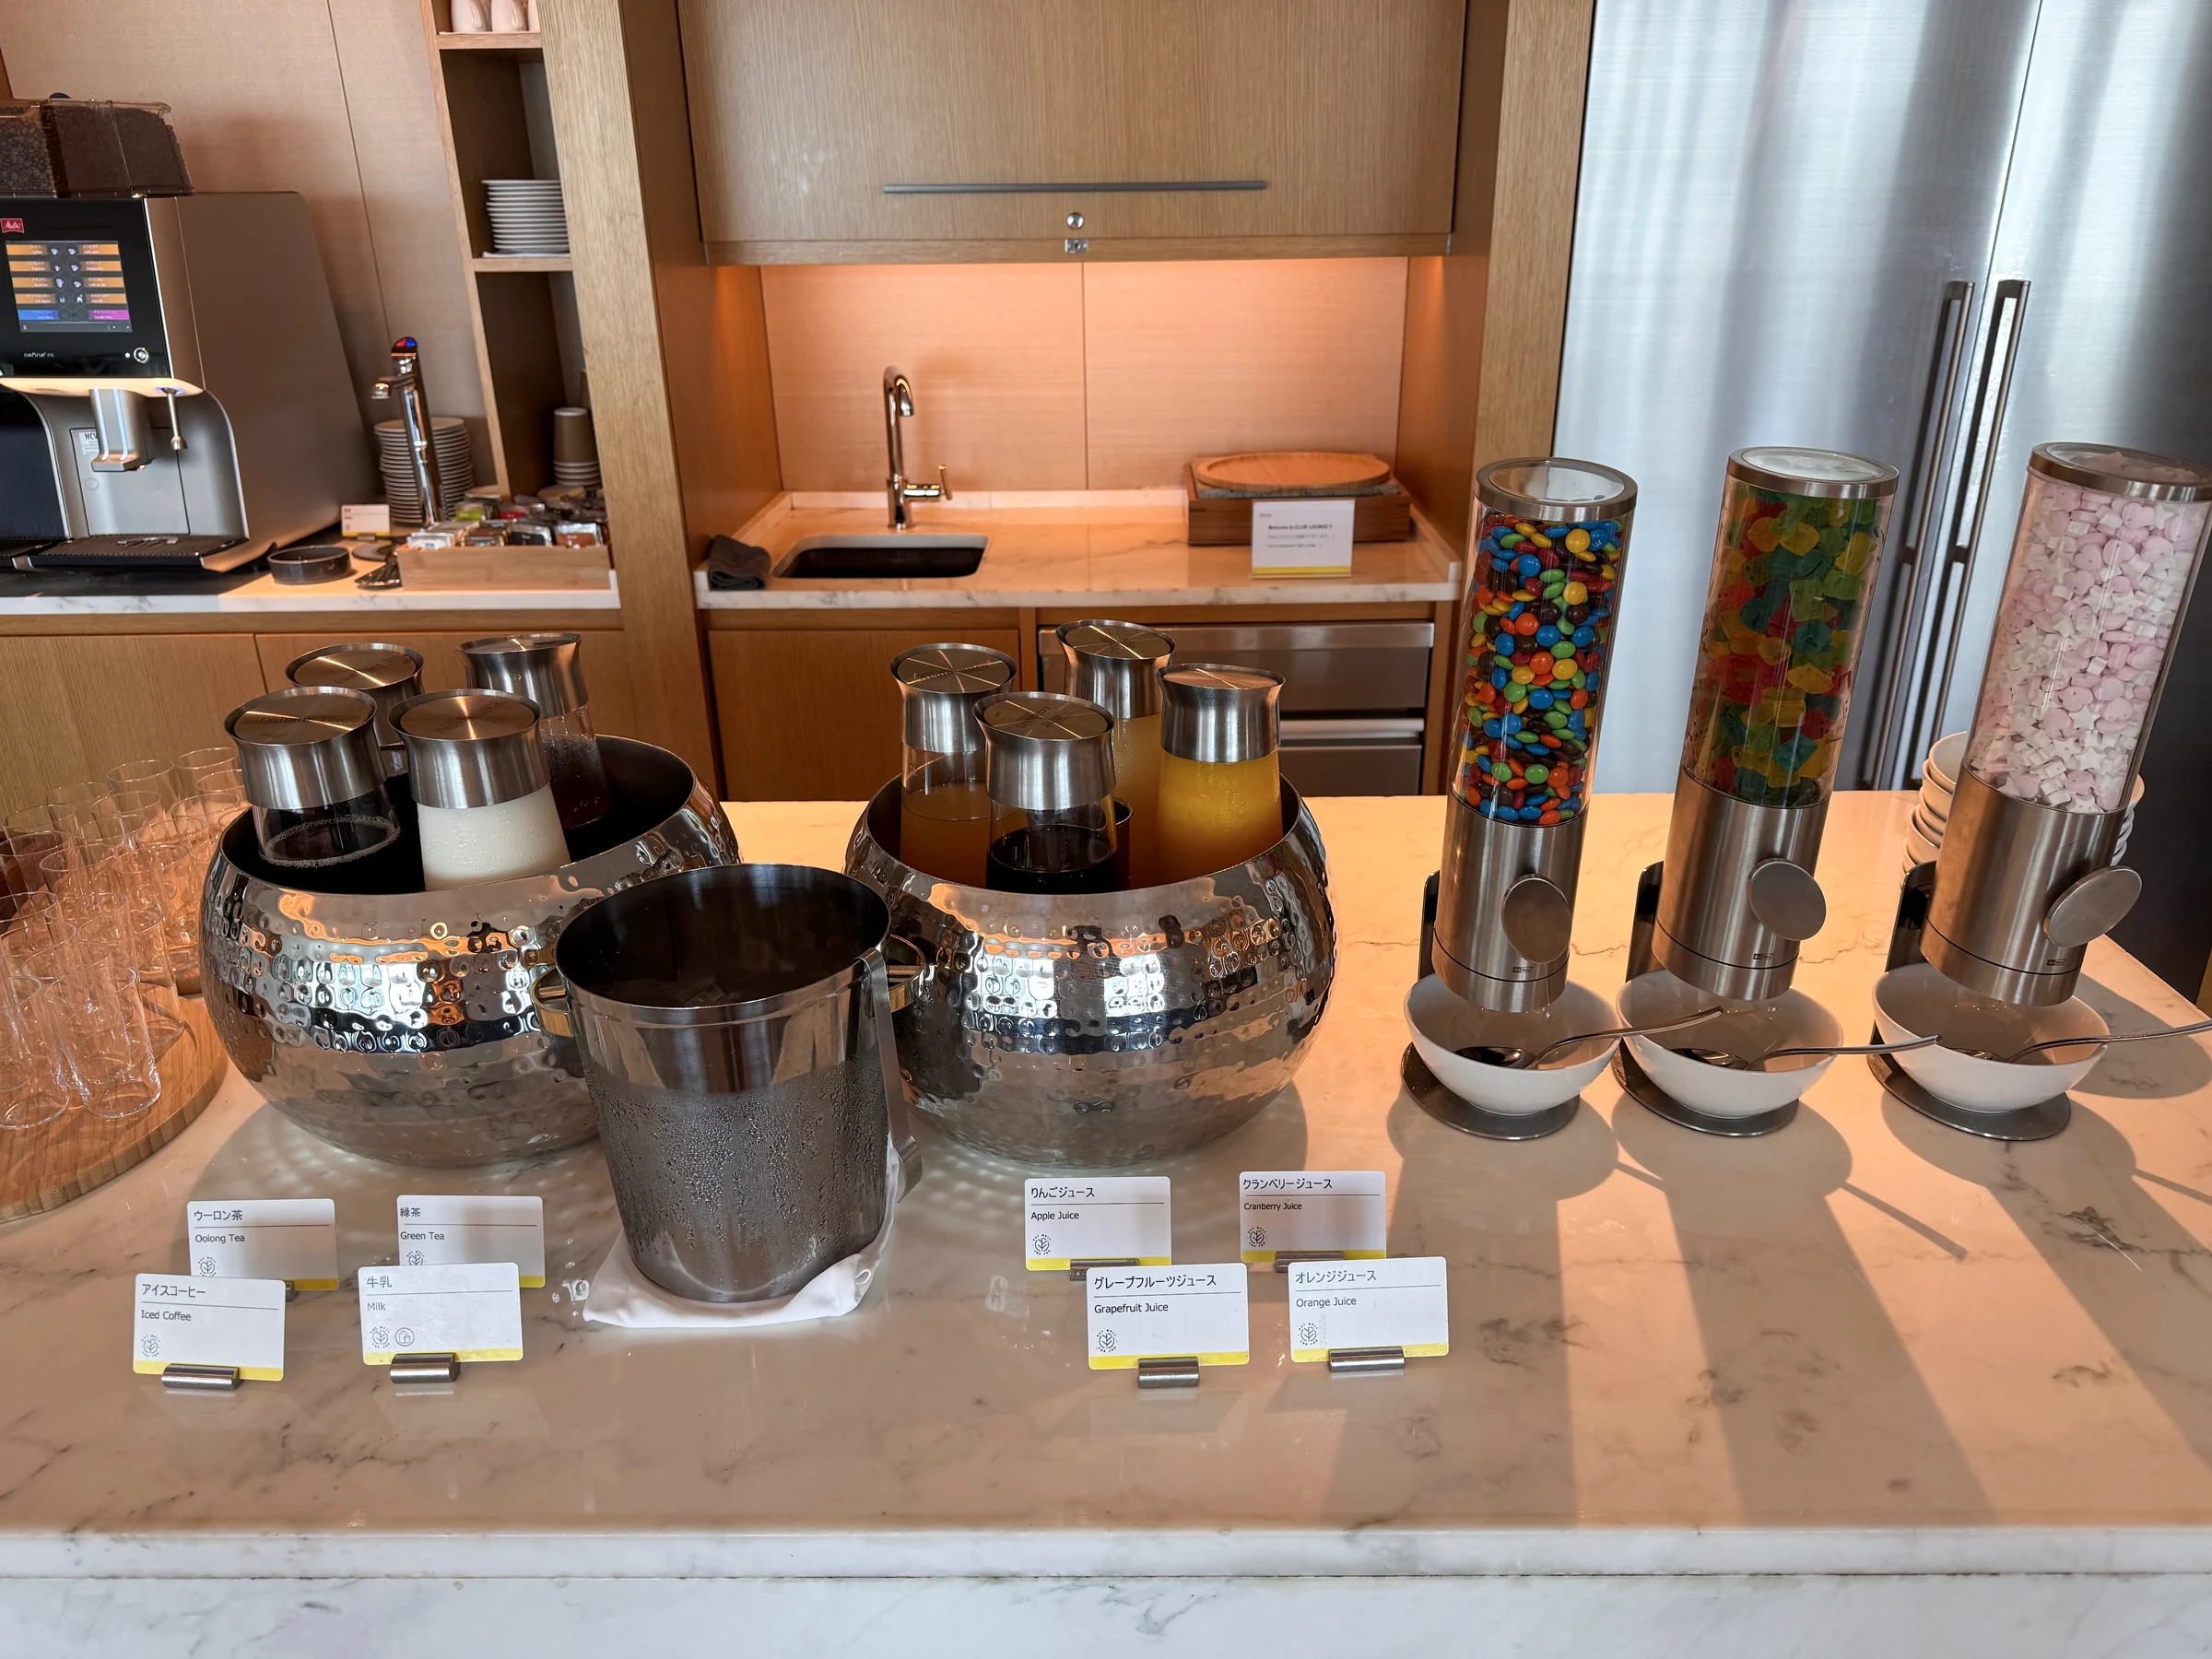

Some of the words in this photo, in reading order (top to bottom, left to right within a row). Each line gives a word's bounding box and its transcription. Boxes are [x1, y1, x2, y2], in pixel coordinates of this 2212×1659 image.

[1242, 1177, 1333, 1190] クランベリージュース
[1030, 1186, 1095, 1198] りんごジュース
[400, 1207, 421, 1218] 緑茶
[1243, 1202, 1281, 1211] Cranberry
[1283, 1202, 1302, 1210] Juice
[194, 1209, 243, 1221] ウーロン茶
[1030, 1211, 1055, 1221] Apple
[1057, 1211, 1079, 1219] Juice
[194, 1234, 227, 1244] Oolong
[228, 1233, 245, 1242] Tea
[400, 1231, 426, 1241] Green
[429, 1231, 445, 1241] Tea
[366, 1276, 393, 1288] 牛乳
[1094, 1274, 1217, 1290] グレープフルーツジュース
[1295, 1269, 1377, 1284] オレンジジュース
[141, 1283, 206, 1298] アイスコーヒー
[367, 1301, 386, 1312] Milk
[1094, 1303, 1142, 1315] Grapefruit
[1145, 1302, 1169, 1312] Juice
[1296, 1298, 1331, 1309] Orange
[1333, 1297, 1357, 1307] Juice
[140, 1310, 160, 1320] Iced
[162, 1311, 192, 1322] Coffee
